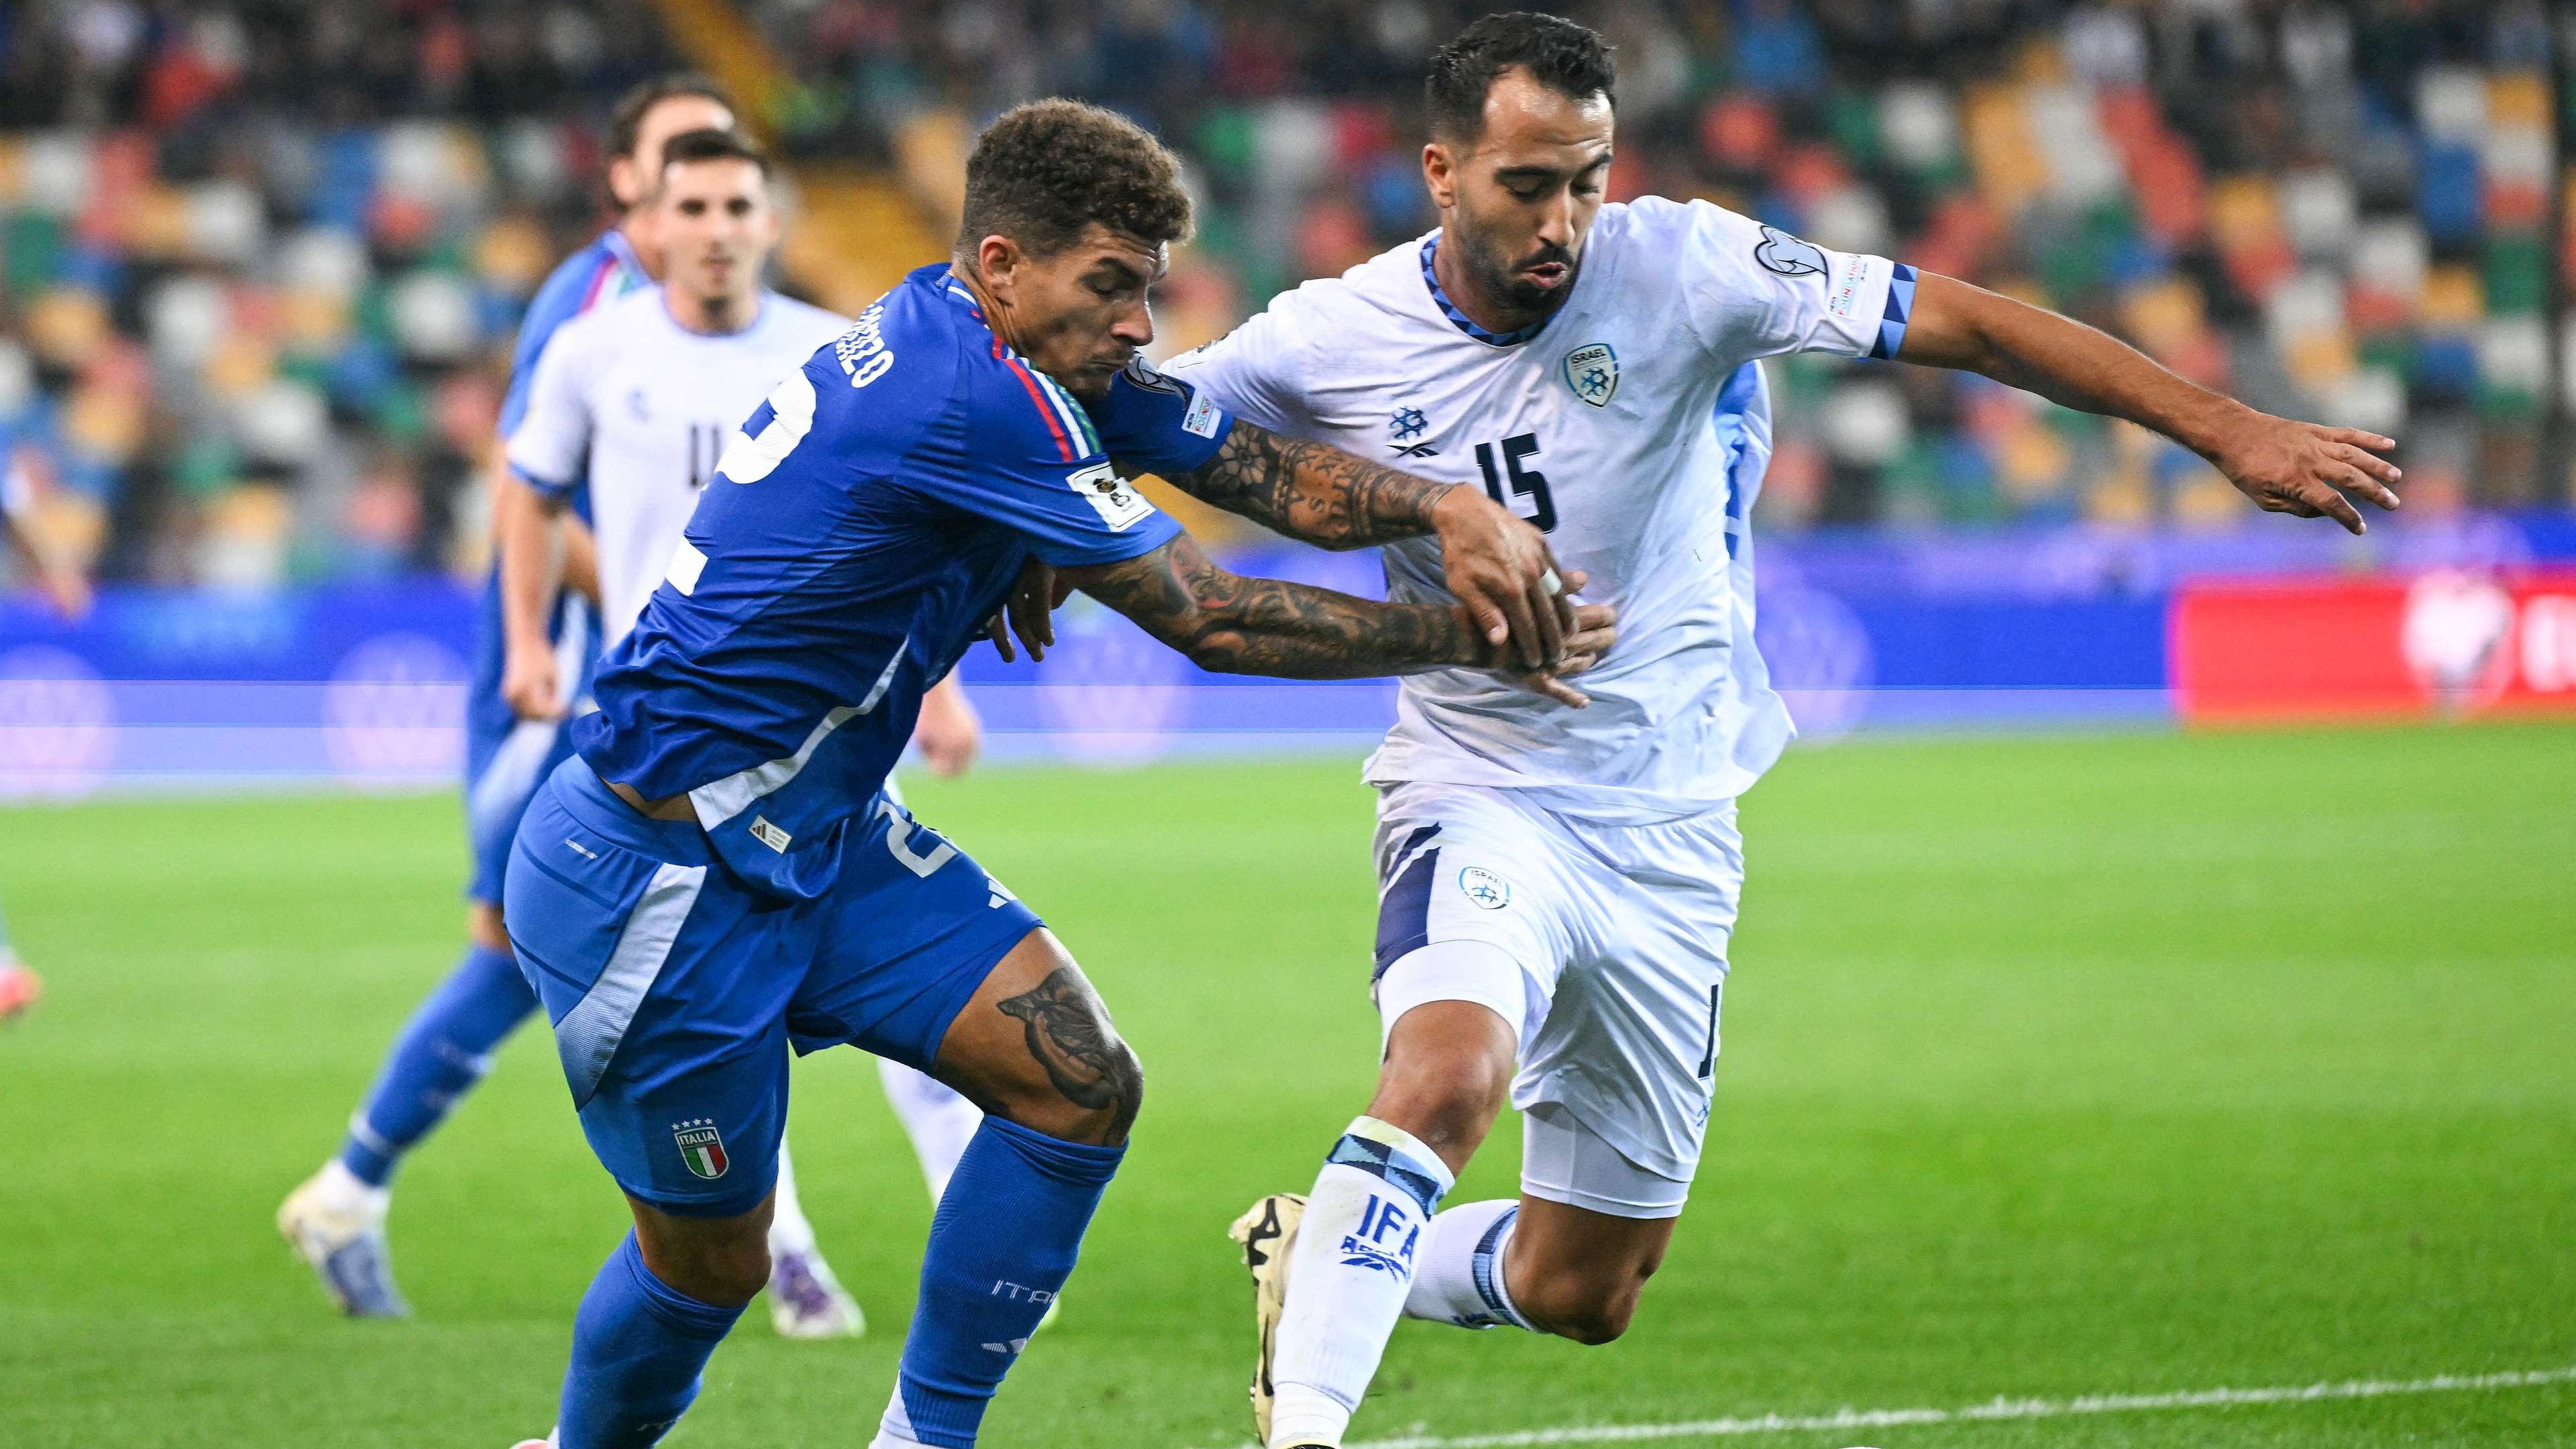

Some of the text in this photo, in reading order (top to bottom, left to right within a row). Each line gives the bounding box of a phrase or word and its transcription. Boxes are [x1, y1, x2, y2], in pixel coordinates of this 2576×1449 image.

[1571, 348, 1607, 364] ISRAEL
[1475, 432, 1558, 535] 15
[678, 1131, 716, 1146] ITALIA
[1356, 1193, 1419, 1266] IFA
